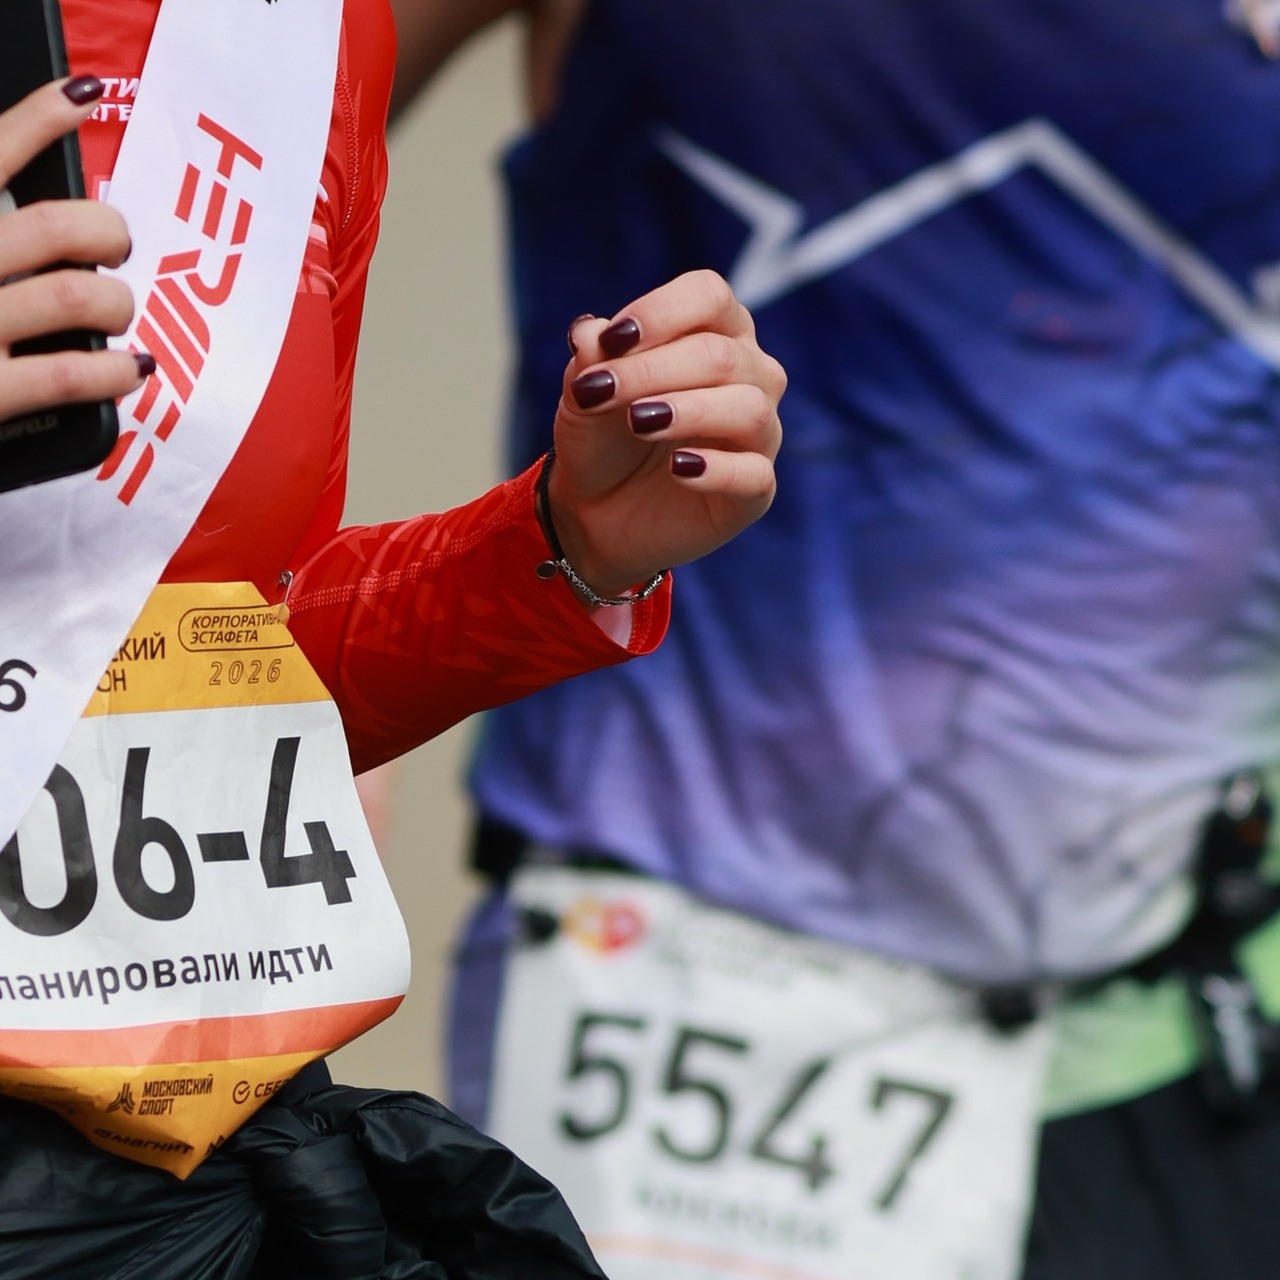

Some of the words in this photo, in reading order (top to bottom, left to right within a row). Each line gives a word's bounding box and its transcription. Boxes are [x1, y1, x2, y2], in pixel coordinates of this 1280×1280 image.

[112, 631, 165, 662] КИЙ
[190, 630, 259, 645] ЭСТАФЕТА
[209, 659, 282, 686] 2026
[250, 942, 333, 986] идти
[142, 1073, 214, 1098] МОСКОВСКИЙ
[138, 1098, 175, 1116] СПОРТ
[556, 1008, 956, 1215] 5547
